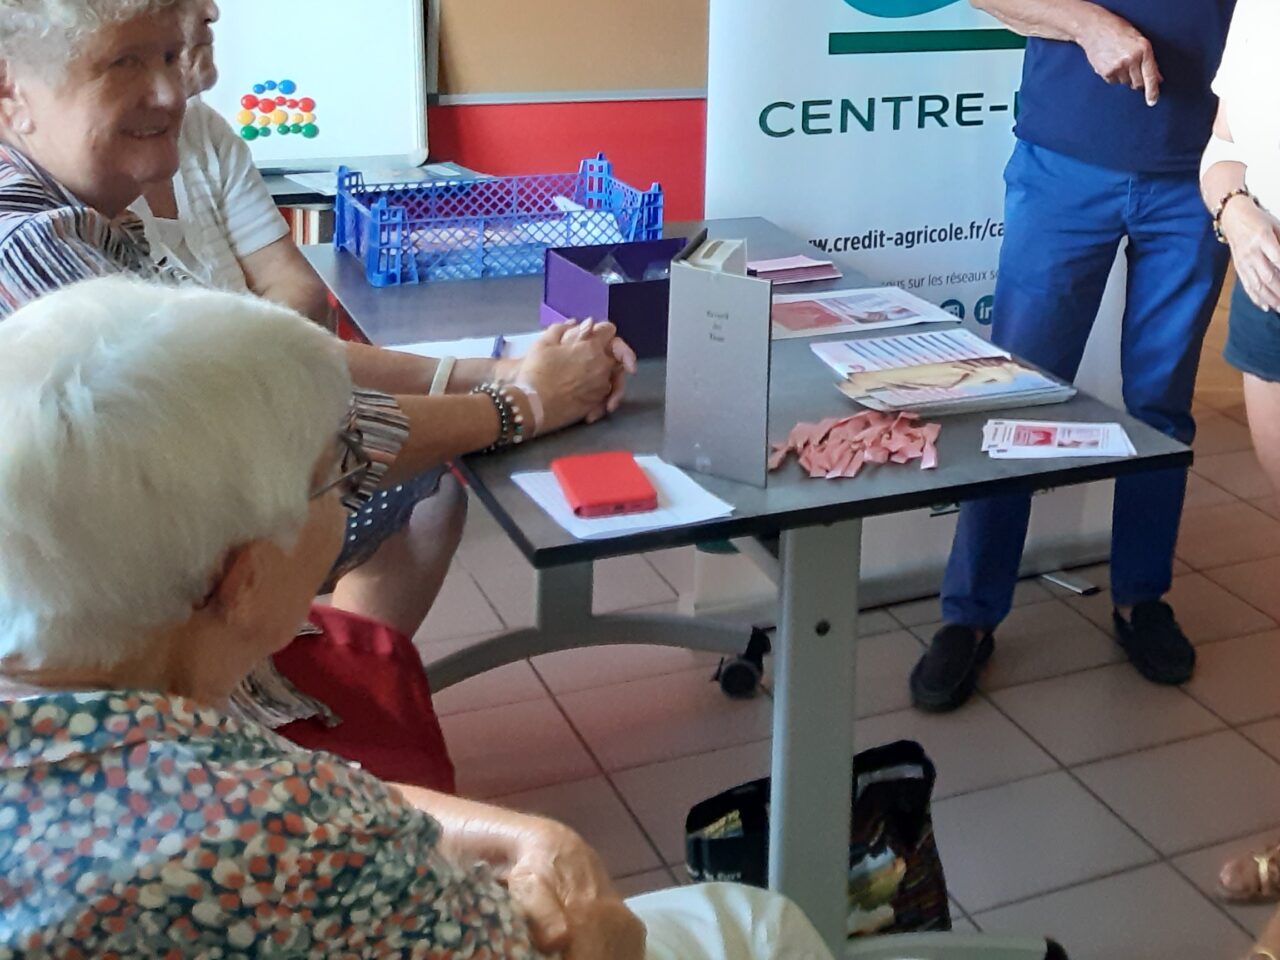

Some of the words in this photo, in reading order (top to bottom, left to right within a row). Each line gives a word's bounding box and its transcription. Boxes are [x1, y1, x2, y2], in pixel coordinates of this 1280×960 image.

[907, 275, 925, 289] sur
[928, 271, 943, 286] les
[945, 270, 988, 285] réseaux
